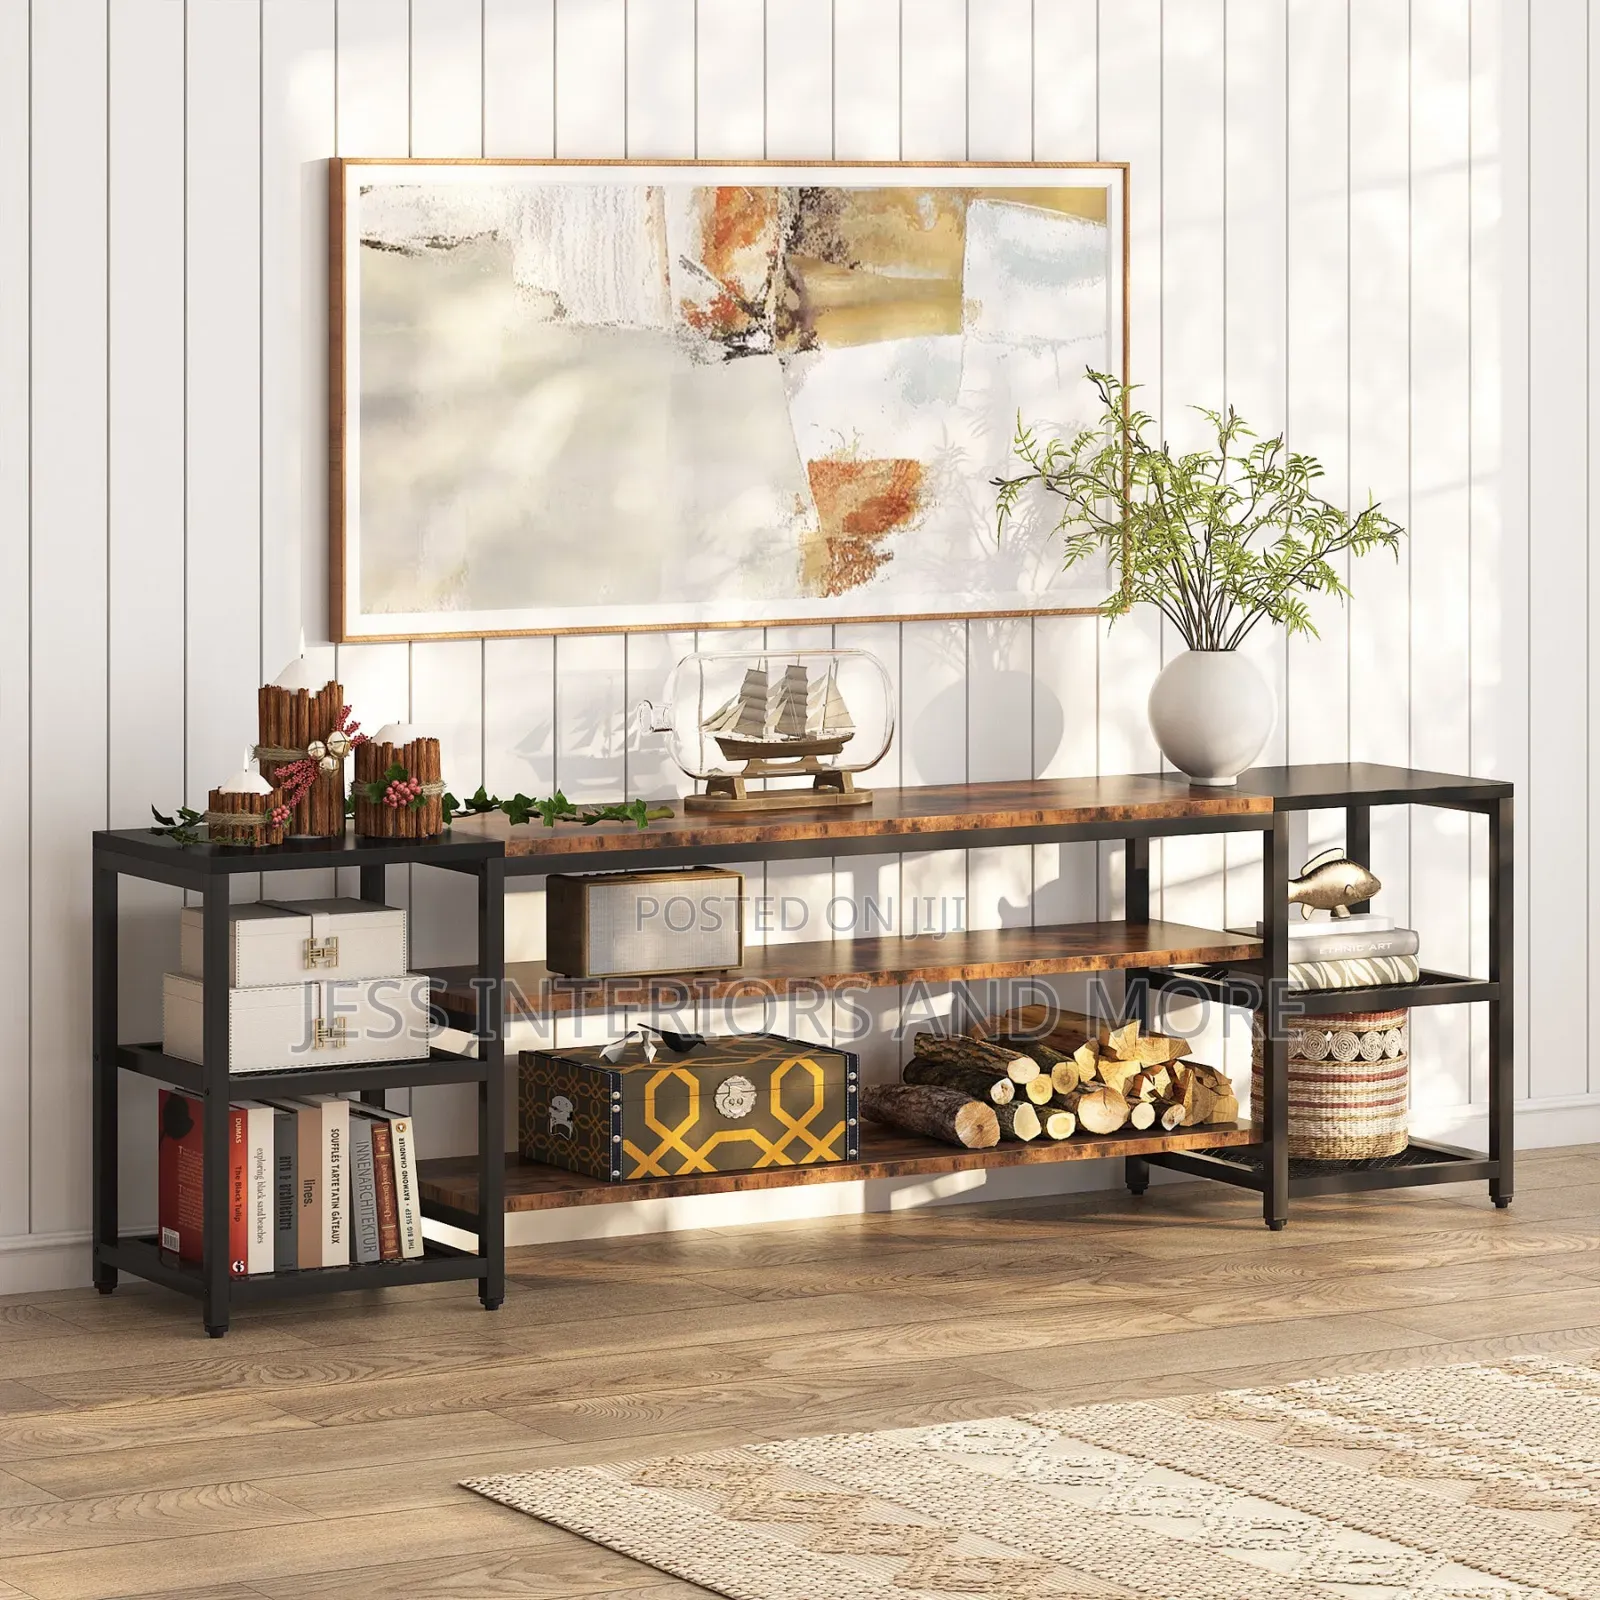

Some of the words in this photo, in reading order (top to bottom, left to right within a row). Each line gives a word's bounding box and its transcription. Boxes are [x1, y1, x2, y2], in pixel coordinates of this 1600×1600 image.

[1319, 944, 1365, 955] ETHNIC
[1367, 942, 1392, 951] ART
[331, 1128, 342, 1163] SOUFFLÉS
[398, 1137, 408, 1169] CHANDLER
[254, 1147, 266, 1180] exploring
[331, 1164, 340, 1187] TARTE
[257, 1181, 266, 1199] black
[303, 1179, 315, 1208] lines.
[331, 1187, 340, 1209] TATIN
[356, 1141, 377, 1254] INNENARCHITEKTUR
[402, 1170, 411, 1201] RAYMOND
[234, 1203, 242, 1222] Tulip
[257, 1200, 266, 1216] sand
[257, 1215, 266, 1244] beaches
[331, 1210, 342, 1244] GÂTEAUX
